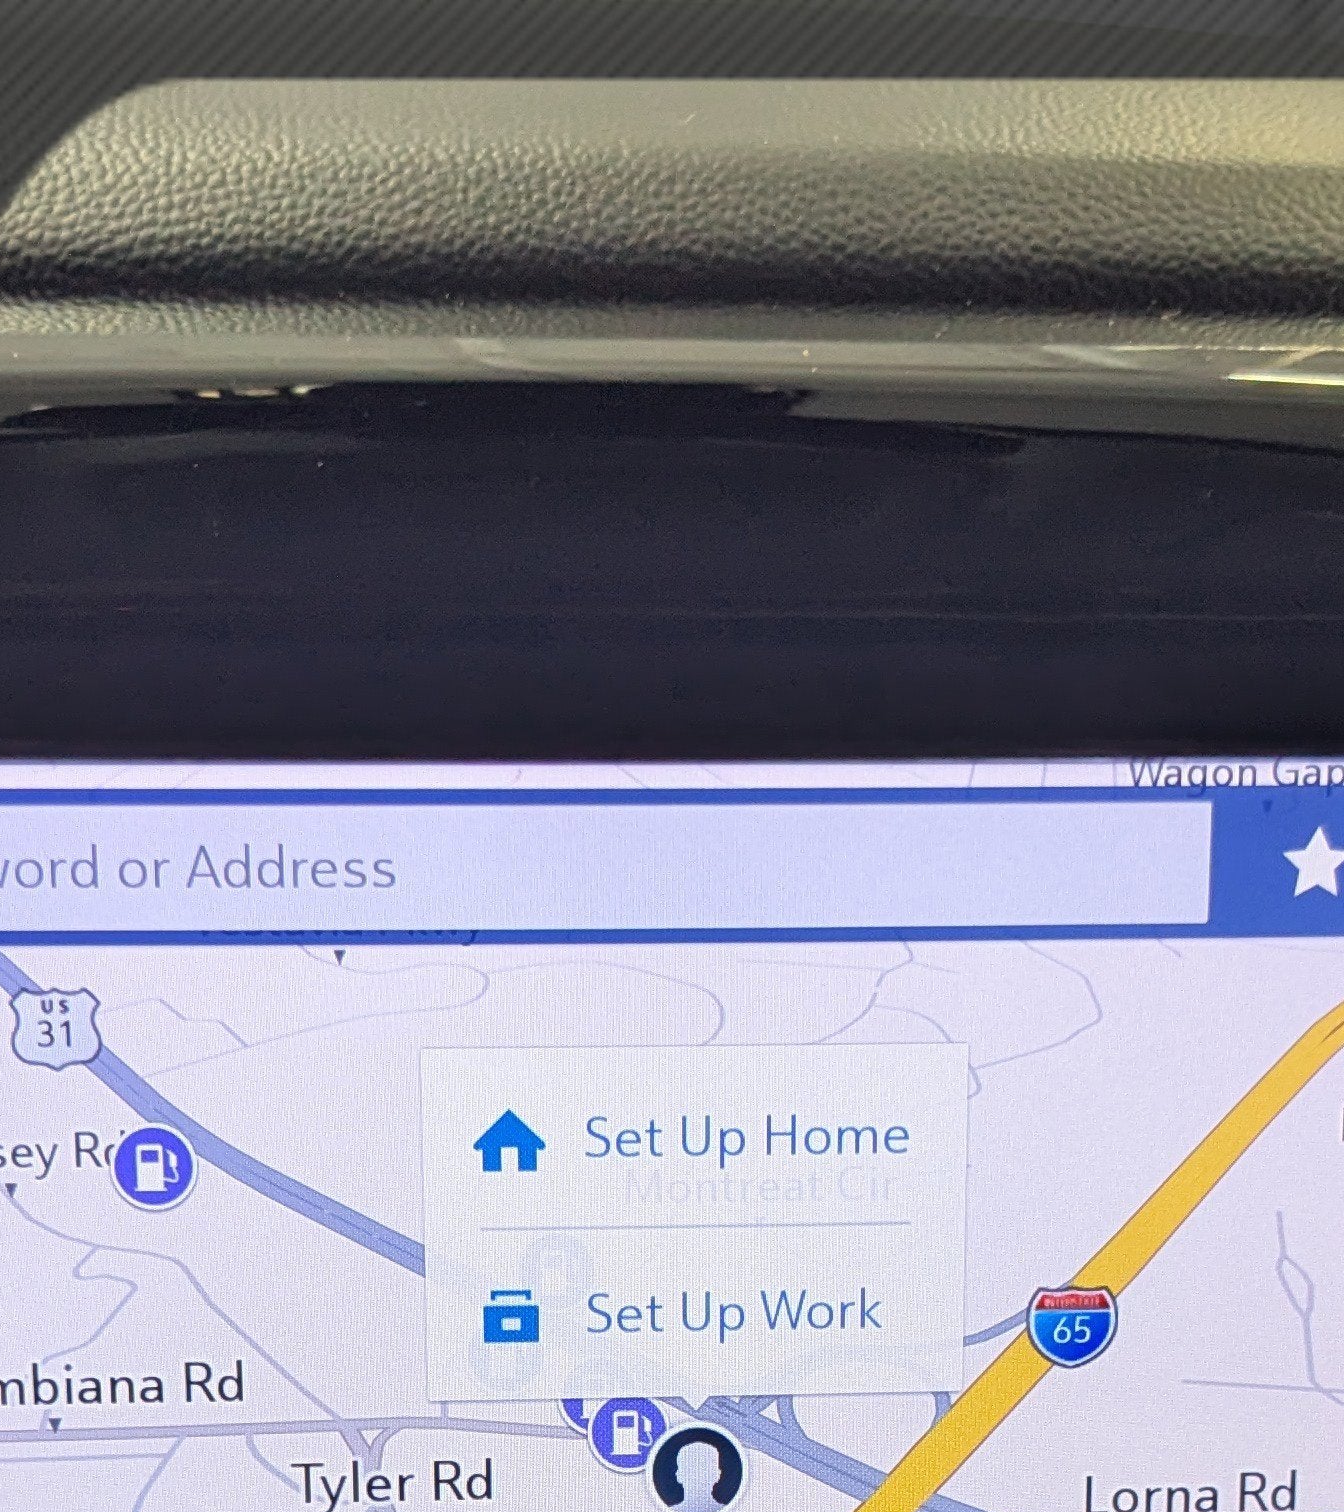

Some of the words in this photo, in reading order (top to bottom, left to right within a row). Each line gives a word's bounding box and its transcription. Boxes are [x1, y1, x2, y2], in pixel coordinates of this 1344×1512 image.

[1130, 756, 1258, 798] Wagon
[118, 859, 168, 889] or
[186, 843, 398, 889] Address
[40, 1000, 70, 1014] US
[37, 1021, 72, 1048] 31
[585, 1117, 663, 1157] Set
[681, 1114, 746, 1169] Up
[766, 1113, 911, 1156] Home
[587, 1291, 665, 1333] Set
[683, 1290, 745, 1343] Up
[760, 1287, 884, 1330] Work
[1053, 1315, 1091, 1344] 65
[184, 1359, 244, 1403] Rd
[434, 1459, 494, 1501] Rd
[1238, 1470, 1298, 1512] Rd
